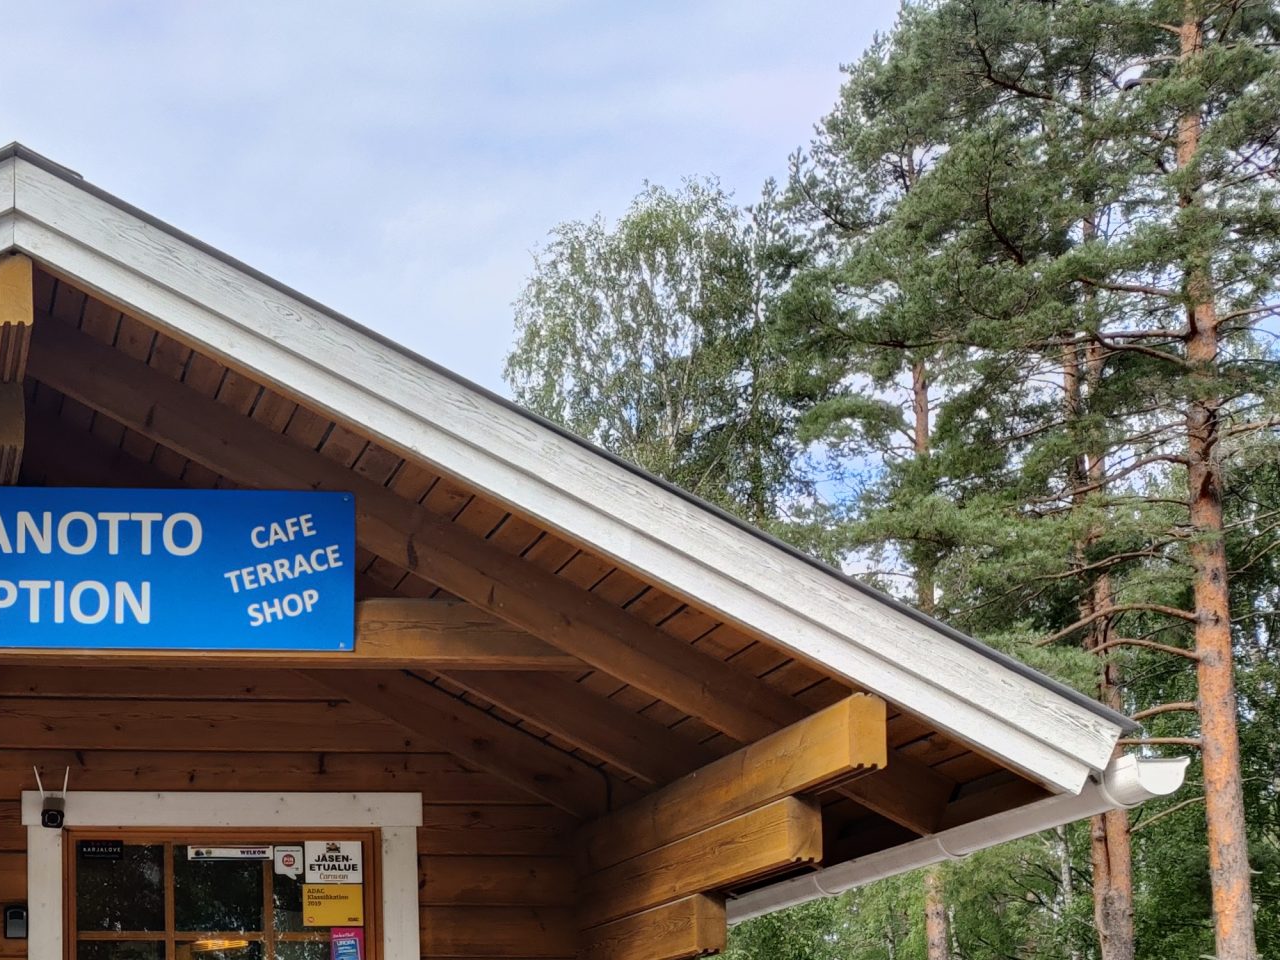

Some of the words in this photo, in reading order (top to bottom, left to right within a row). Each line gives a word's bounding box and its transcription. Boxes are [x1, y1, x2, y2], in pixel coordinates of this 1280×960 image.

[250, 514, 317, 549] CAFE
[223, 545, 343, 593] TERRACE
[247, 589, 319, 627] SHOP
[309, 863, 359, 872] ETUALUE
[314, 853, 353, 863] JÄSEN-
